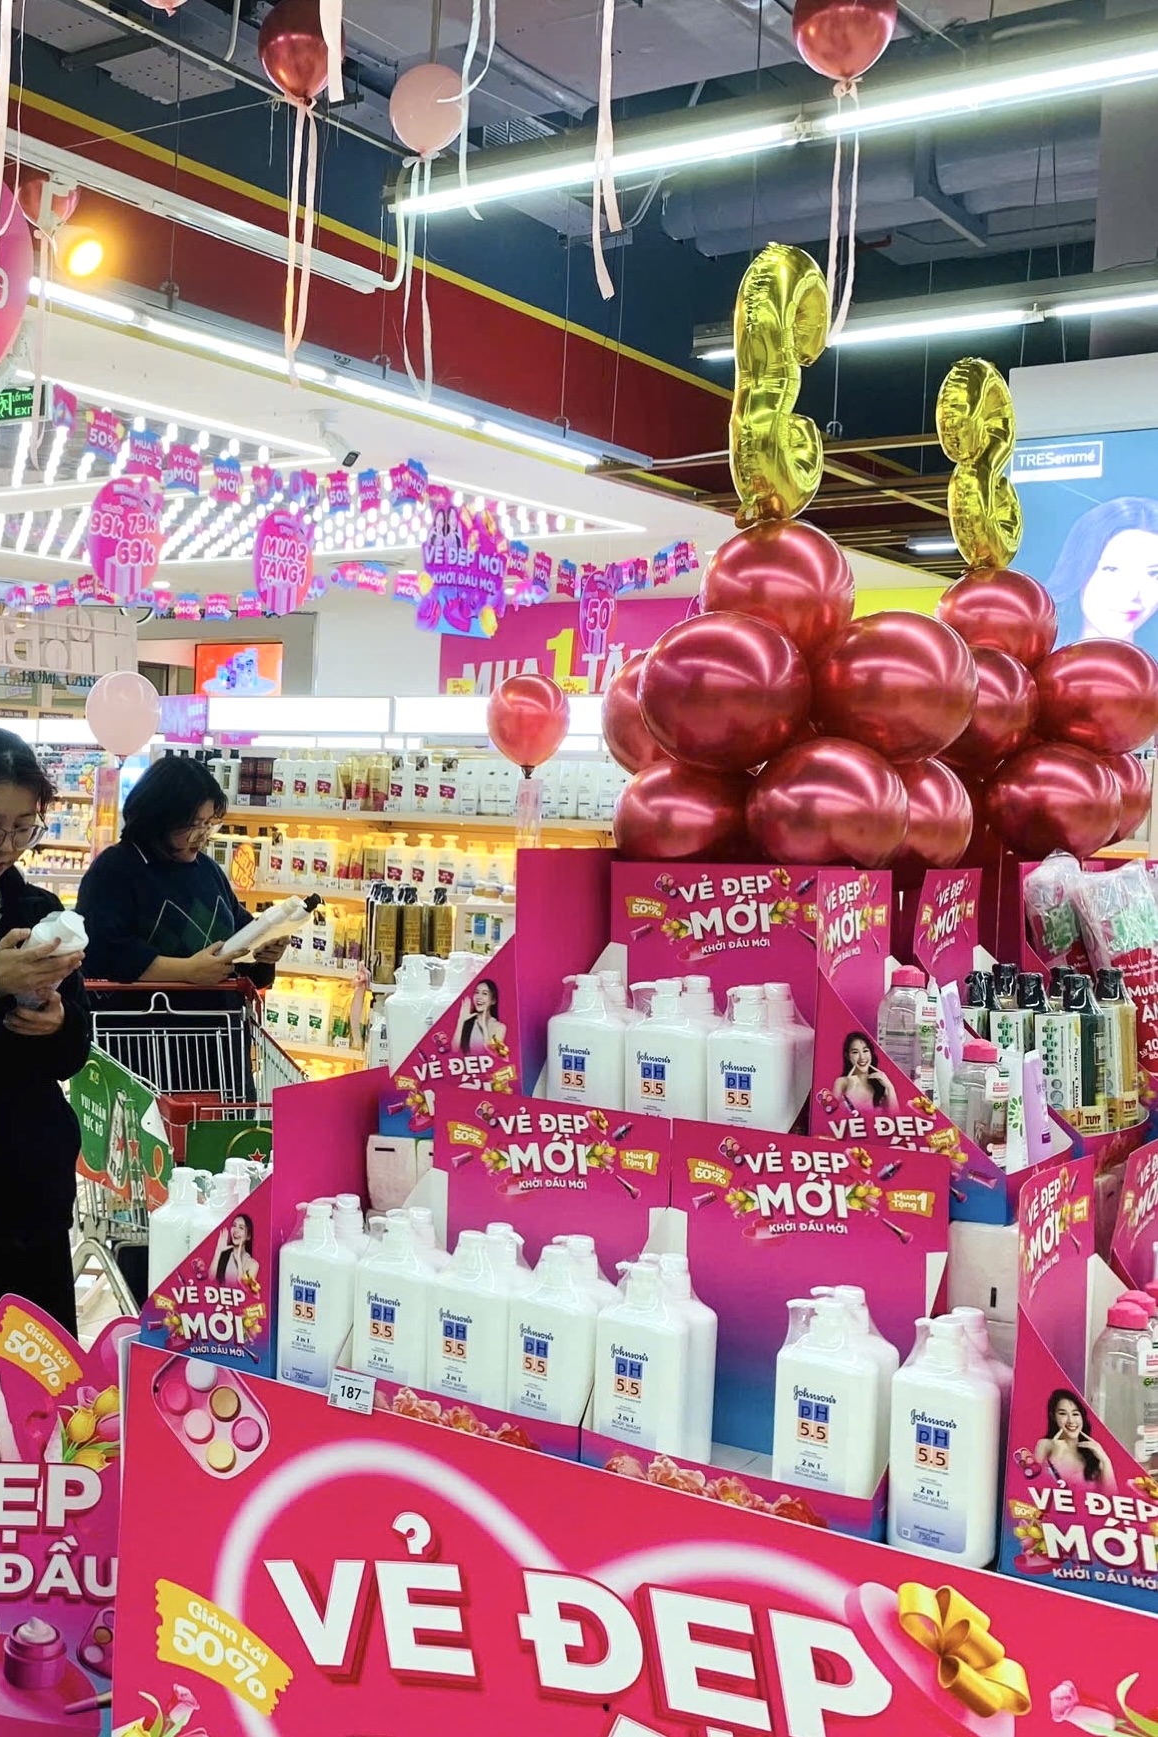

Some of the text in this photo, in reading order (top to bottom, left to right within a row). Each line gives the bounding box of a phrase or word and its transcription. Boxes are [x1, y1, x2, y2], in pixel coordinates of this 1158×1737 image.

[89, 427, 118, 453] 50%
[1017, 449, 1096, 468] TRESemmé
[173, 466, 197, 485] MỚI
[218, 476, 240, 494] MỚI
[116, 538, 156, 567] 69k
[546, 628, 577, 682] 1
[679, 873, 773, 904] VẺ ĐẸP
[631, 903, 663, 917] 50%
[690, 896, 772, 941] MỚI
[828, 905, 864, 953] MỚI
[701, 937, 771, 955] KHỞI ĐẦU MỚI
[558, 1043, 592, 1057] Johnson's
[636, 1051, 671, 1065] Johnson's
[413, 1054, 494, 1081] VẺ ĐẸP
[563, 1056, 585, 1071] pH
[643, 1065, 665, 1079] pH
[720, 1060, 757, 1075] Johnson's
[563, 1073, 585, 1087] 5.5
[643, 1081, 665, 1095] 5.5
[727, 1074, 751, 1090] pH
[727, 1092, 750, 1106] 5.5
[497, 1107, 590, 1138] VẺ ĐẸP
[828, 1110, 935, 1140] VẺ ĐẸP
[453, 1130, 482, 1146] 50%
[508, 1133, 588, 1176] MỚI
[744, 1143, 850, 1181] VẺ ĐẸP
[519, 1176, 588, 1190] KHỞI ĐẦU MỚI
[694, 1167, 727, 1185] 50%
[756, 1171, 849, 1219] MỚI
[893, 1191, 929, 1211] Mua 1
[769, 1219, 849, 1234] KHỞI ĐẦU MỚI
[1029, 1206, 1061, 1272] MỚI
[290, 1274, 322, 1288] Johnson's
[171, 1280, 247, 1310] VẺ ĐẸP
[295, 1288, 315, 1303] pH
[367, 1291, 401, 1307] Johnson's
[294, 1304, 315, 1319] 5.5
[371, 1304, 394, 1321] pH
[439, 1308, 474, 1324] Johnson's
[179, 1305, 244, 1345] MỚI
[372, 1322, 394, 1338] 5.5
[444, 1323, 467, 1339] pH
[519, 1323, 554, 1341] Johnson's
[23, 1321, 55, 1354] Giảm
[444, 1340, 466, 1356] 5.5
[525, 1339, 548, 1357] pH
[611, 1344, 649, 1362] Johnson's
[3, 1330, 62, 1388] 50%
[524, 1356, 548, 1374] 5.5
[617, 1360, 642, 1377] pH
[341, 1385, 362, 1400] 187
[616, 1379, 641, 1396] 5.5
[793, 1384, 837, 1404] Johnson's
[799, 1403, 828, 1422] pH
[910, 1408, 957, 1430] Johnson's
[800, 1422, 827, 1440] 5.5
[918, 1428, 949, 1448] pH
[917, 1447, 947, 1467] 5.5
[1028, 1480, 1158, 1526] VẺ ĐẸP
[1042, 1516, 1158, 1573] MỚI
[1052, 1565, 1129, 1585] KHỞI ĐẦU
[262, 1511, 893, 1737] VẺ ĐẸP
[187, 1600, 270, 1668] Giảm tới
[171, 1617, 268, 1701] 50%
